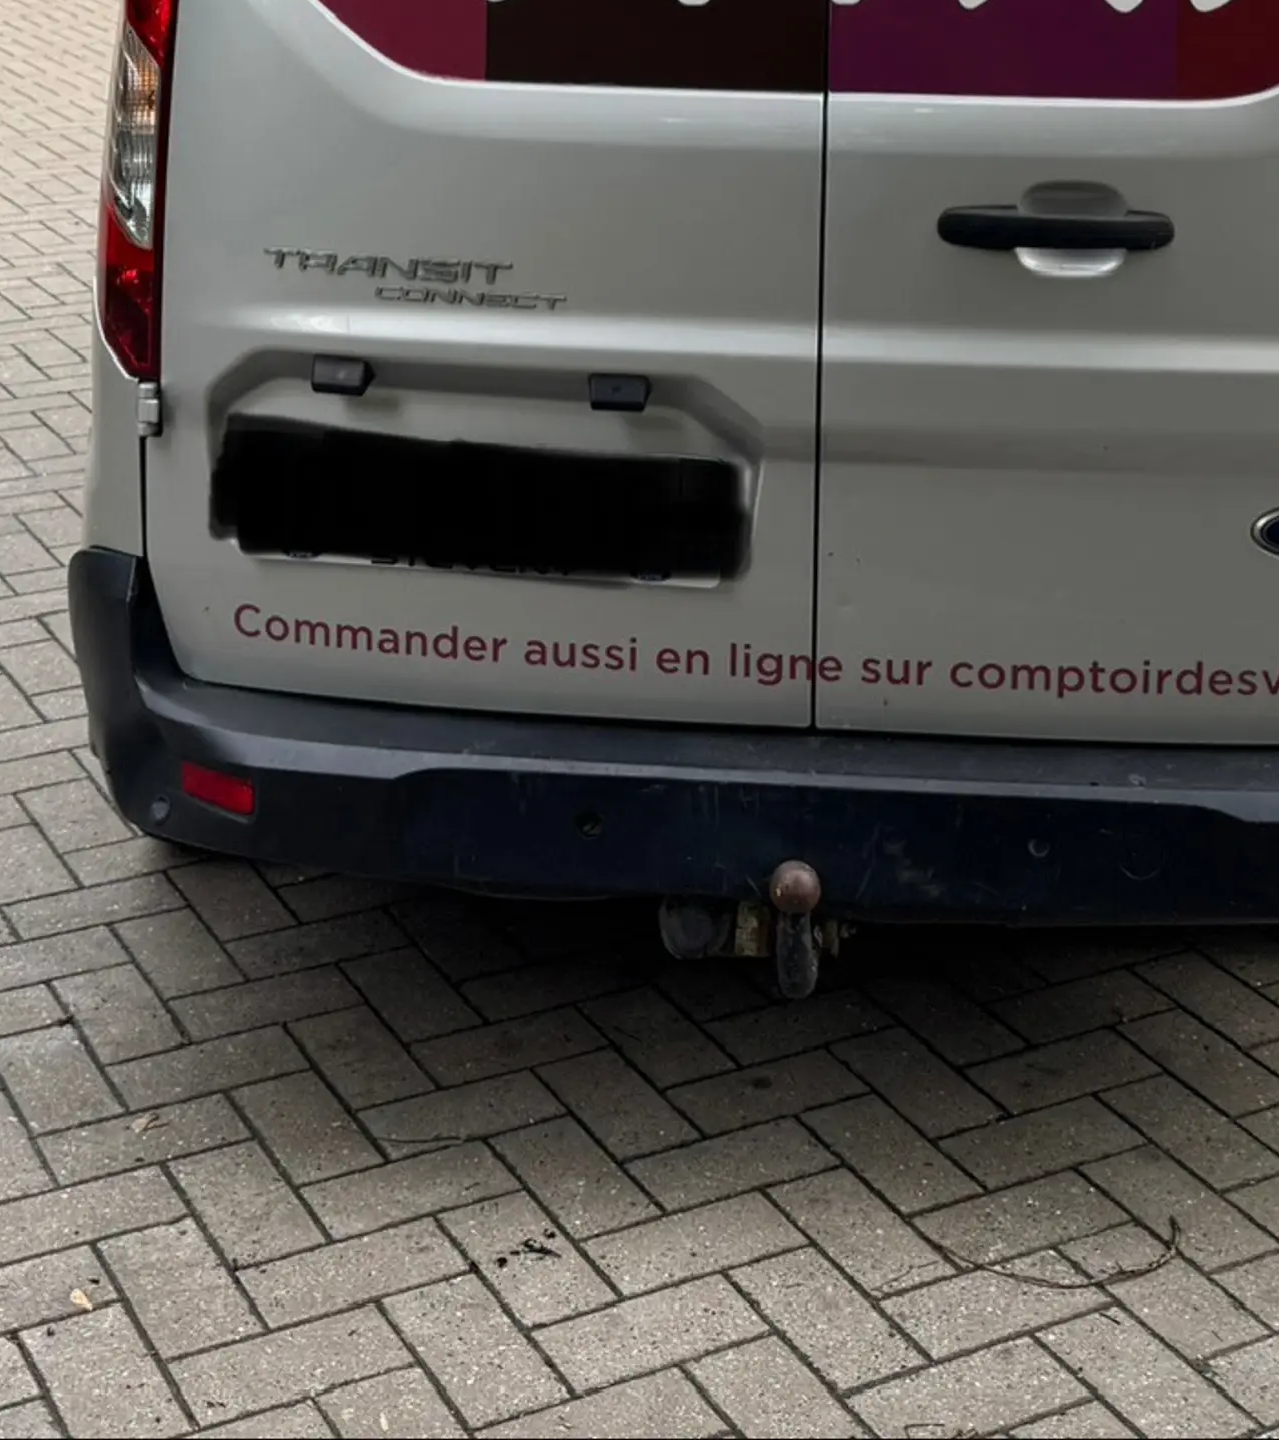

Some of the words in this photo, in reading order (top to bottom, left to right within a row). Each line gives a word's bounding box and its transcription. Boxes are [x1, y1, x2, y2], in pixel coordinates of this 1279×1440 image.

[263, 246, 513, 284] TRANSIT
[374, 286, 568, 310] CONNECT
[233, 604, 507, 664] Commander
[525, 638, 638, 673] aussi
[655, 647, 710, 677] en
[729, 644, 842, 689] ligne
[861, 658, 932, 687] sur
